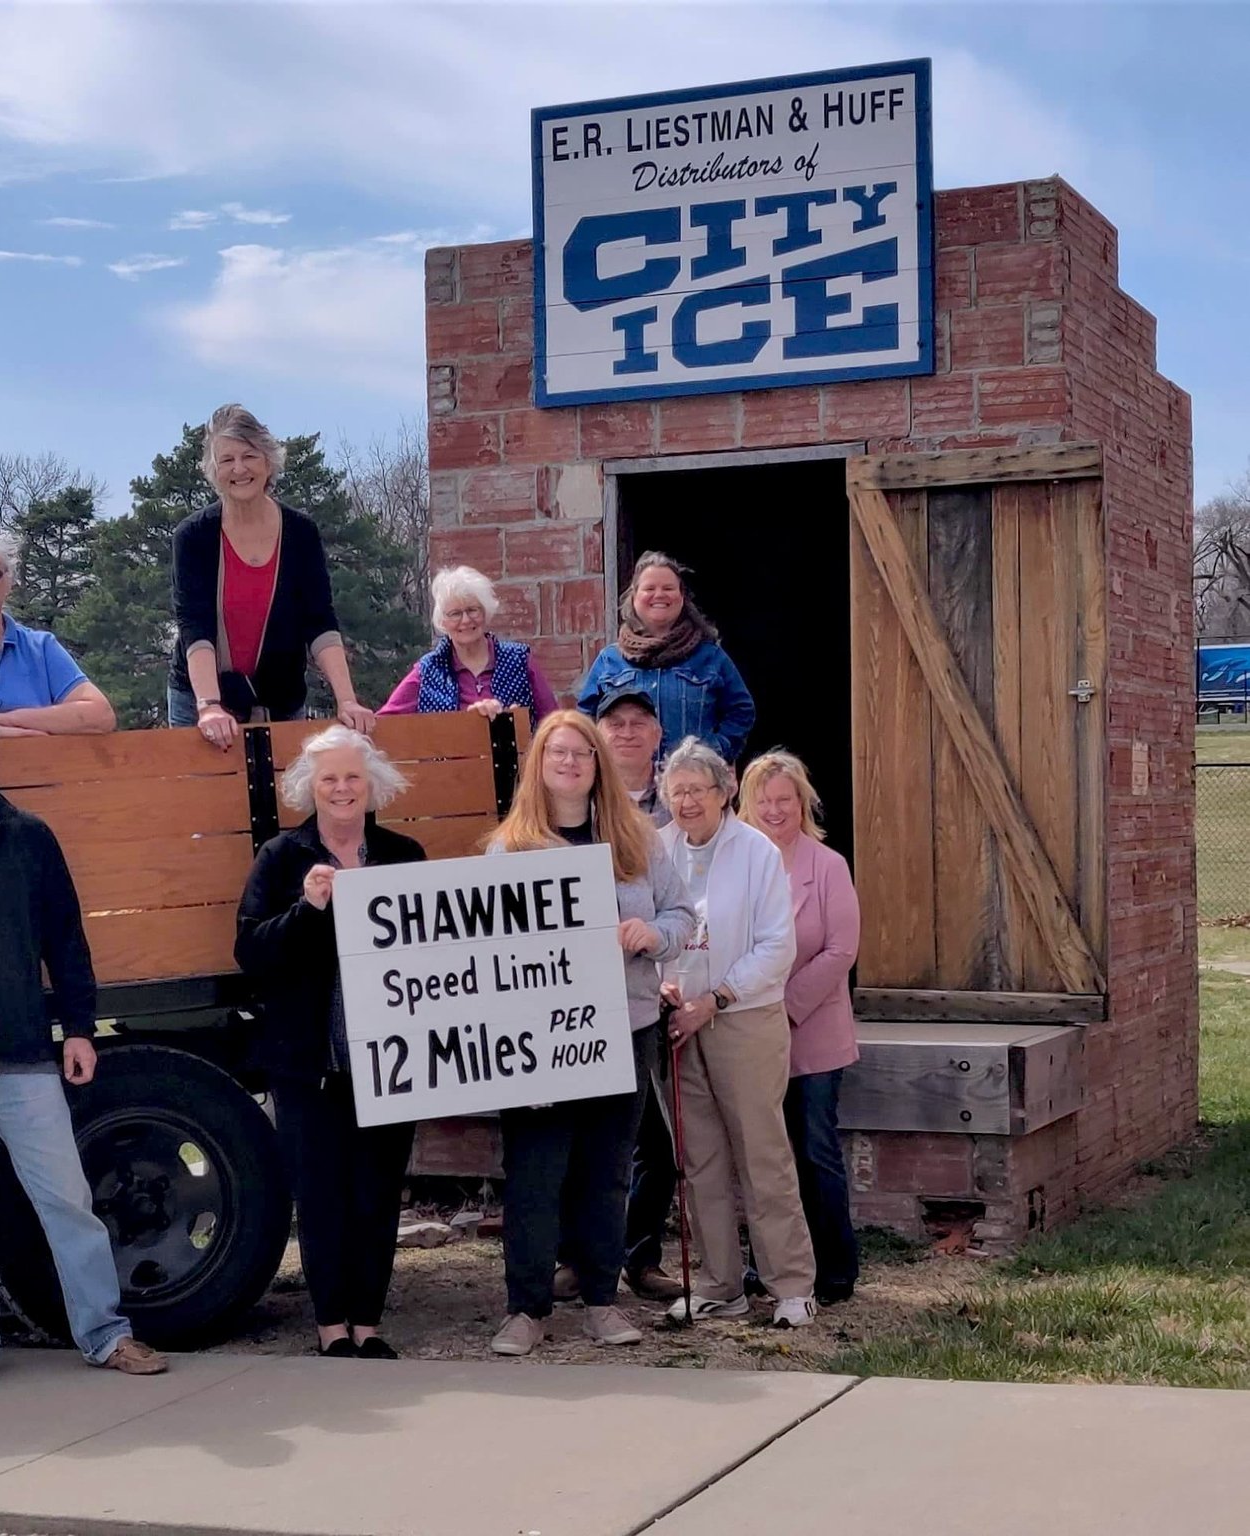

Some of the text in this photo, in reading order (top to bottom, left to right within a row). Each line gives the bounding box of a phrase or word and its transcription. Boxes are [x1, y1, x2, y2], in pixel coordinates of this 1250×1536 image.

[552, 88, 905, 161] E.R. LIESTMAN & HUFF
[632, 143, 820, 191] Distributors of
[562, 181, 898, 313] CITY
[612, 236, 899, 376] ICE
[367, 876, 585, 949] SHAWNEE
[382, 947, 573, 1016] Speed Limit
[549, 1004, 597, 1033] PER
[551, 1039, 608, 1070] HOUR
[366, 1022, 538, 1098] 12 Miles
